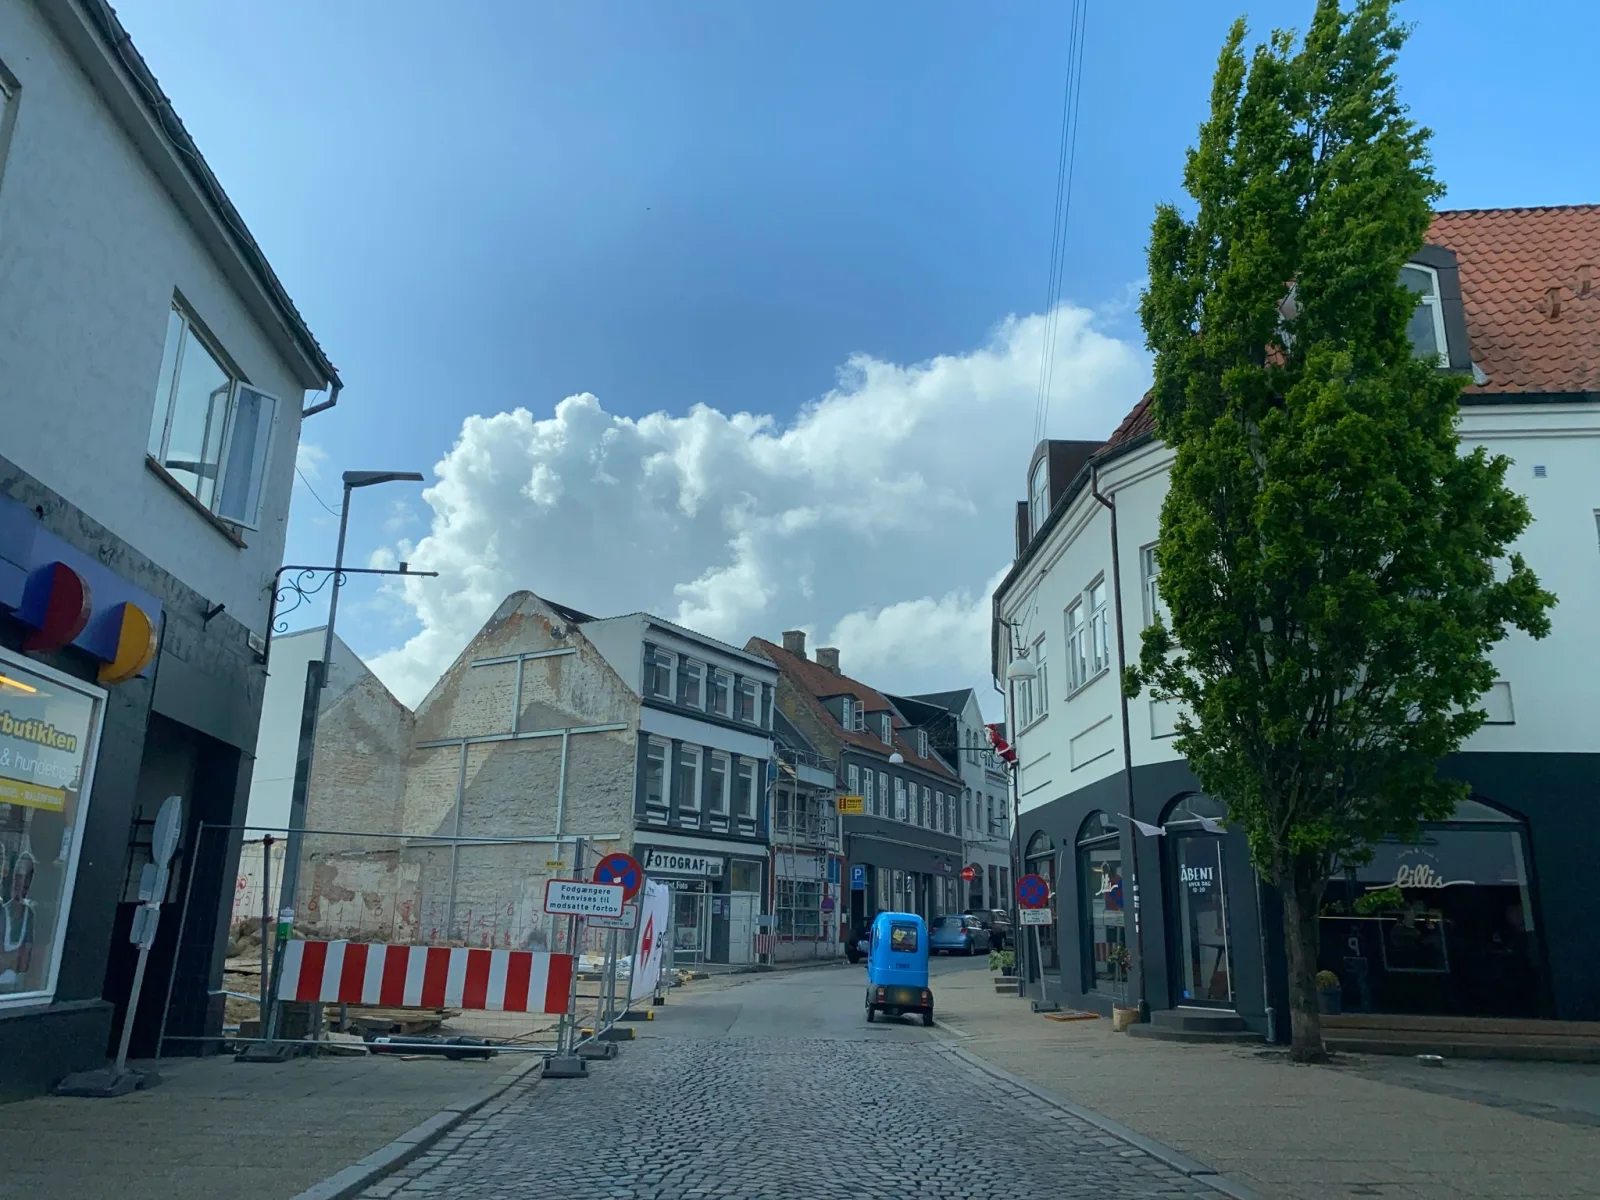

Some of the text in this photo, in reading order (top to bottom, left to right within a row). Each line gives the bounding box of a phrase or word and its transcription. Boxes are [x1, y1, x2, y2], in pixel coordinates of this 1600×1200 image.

[647, 853, 705, 870] FOTOGRAF
[854, 868, 862, 880] P
[1180, 864, 1213, 882] ÅBENT
[561, 884, 611, 896] Fodgængere
[560, 893, 610, 904] henvises til
[549, 902, 618, 912] modsatte fortov
